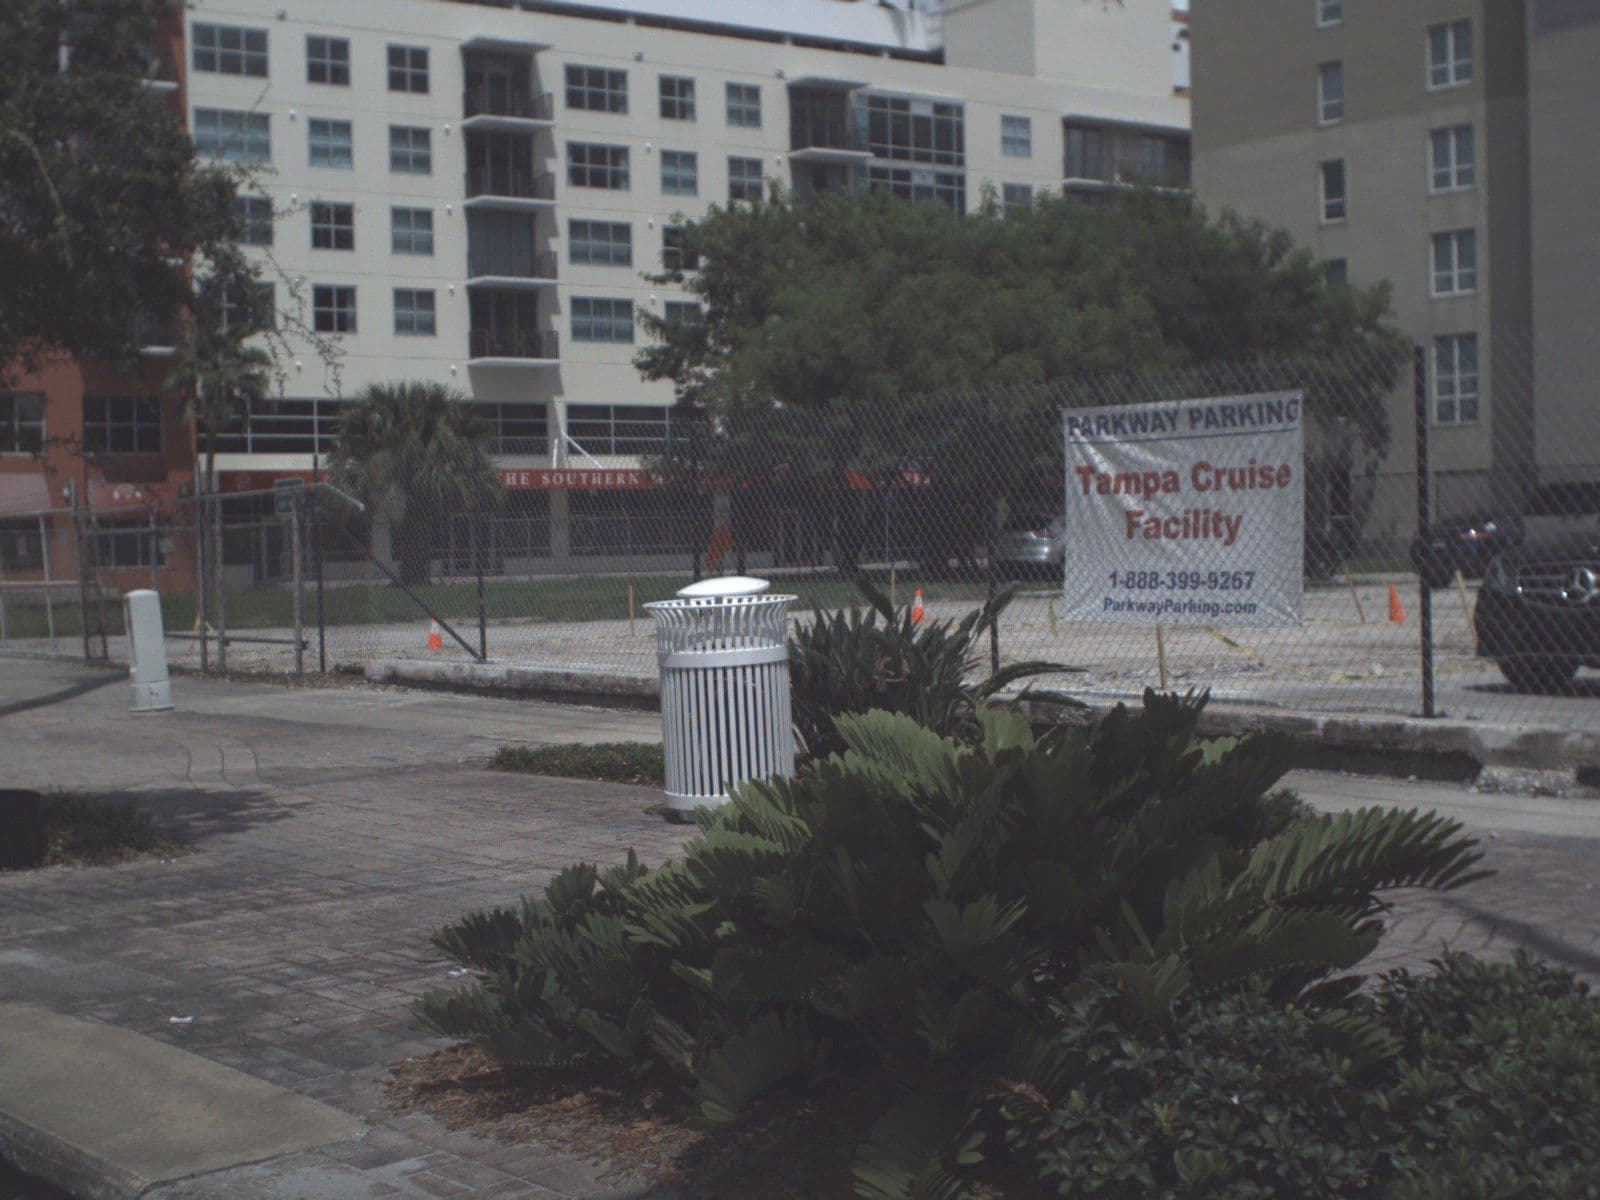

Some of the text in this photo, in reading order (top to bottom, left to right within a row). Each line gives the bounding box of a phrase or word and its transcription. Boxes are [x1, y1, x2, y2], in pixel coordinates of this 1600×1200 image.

[1068, 398, 1300, 436] PARKWAY PARKING
[505, 471, 530, 485] HE
[541, 471, 640, 485] SOUTHERN
[1076, 457, 1292, 501] Tampa Cruise
[1125, 508, 1243, 546] Facility
[1108, 569, 1255, 591] 1-888-399-9267
[1102, 596, 1257, 617] ParkwayParking.com
